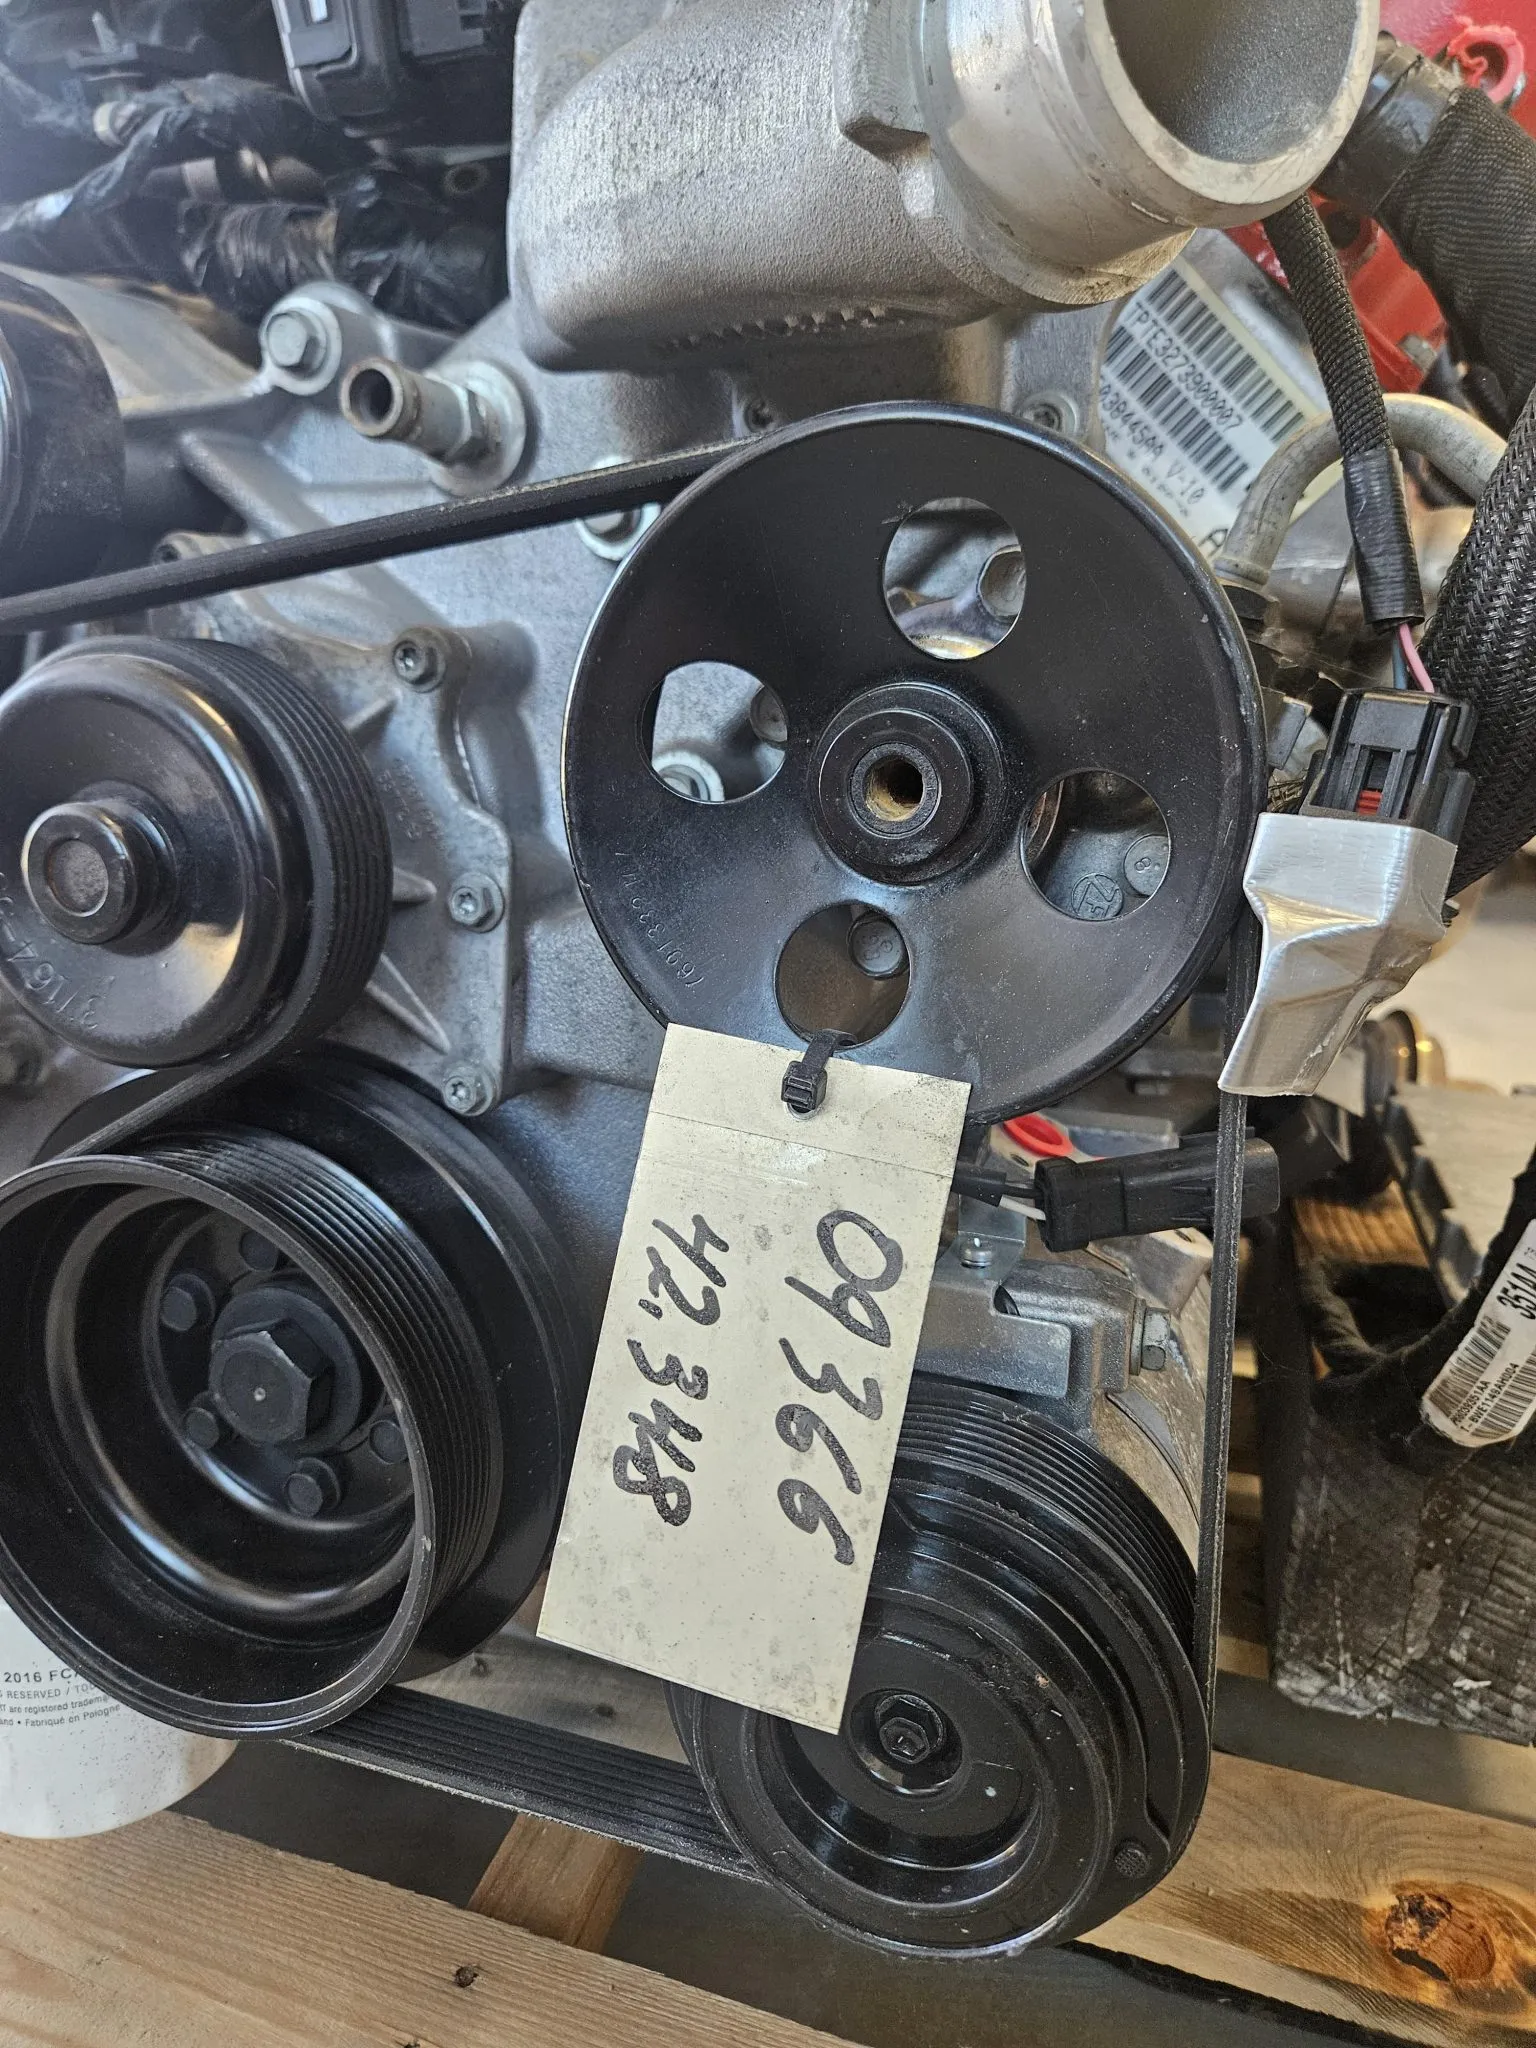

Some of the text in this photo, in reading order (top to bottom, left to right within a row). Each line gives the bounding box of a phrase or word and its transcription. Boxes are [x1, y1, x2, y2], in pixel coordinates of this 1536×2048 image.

[1100, 375, 1164, 458] 038445AA
[775, 1209, 903, 1566] 09366
[4, 1671, 42, 1683] 2016
[7, 1688, 61, 1699] RESERVED
[9, 1706, 22, 1714] are
[25, 1702, 68, 1715] registered
